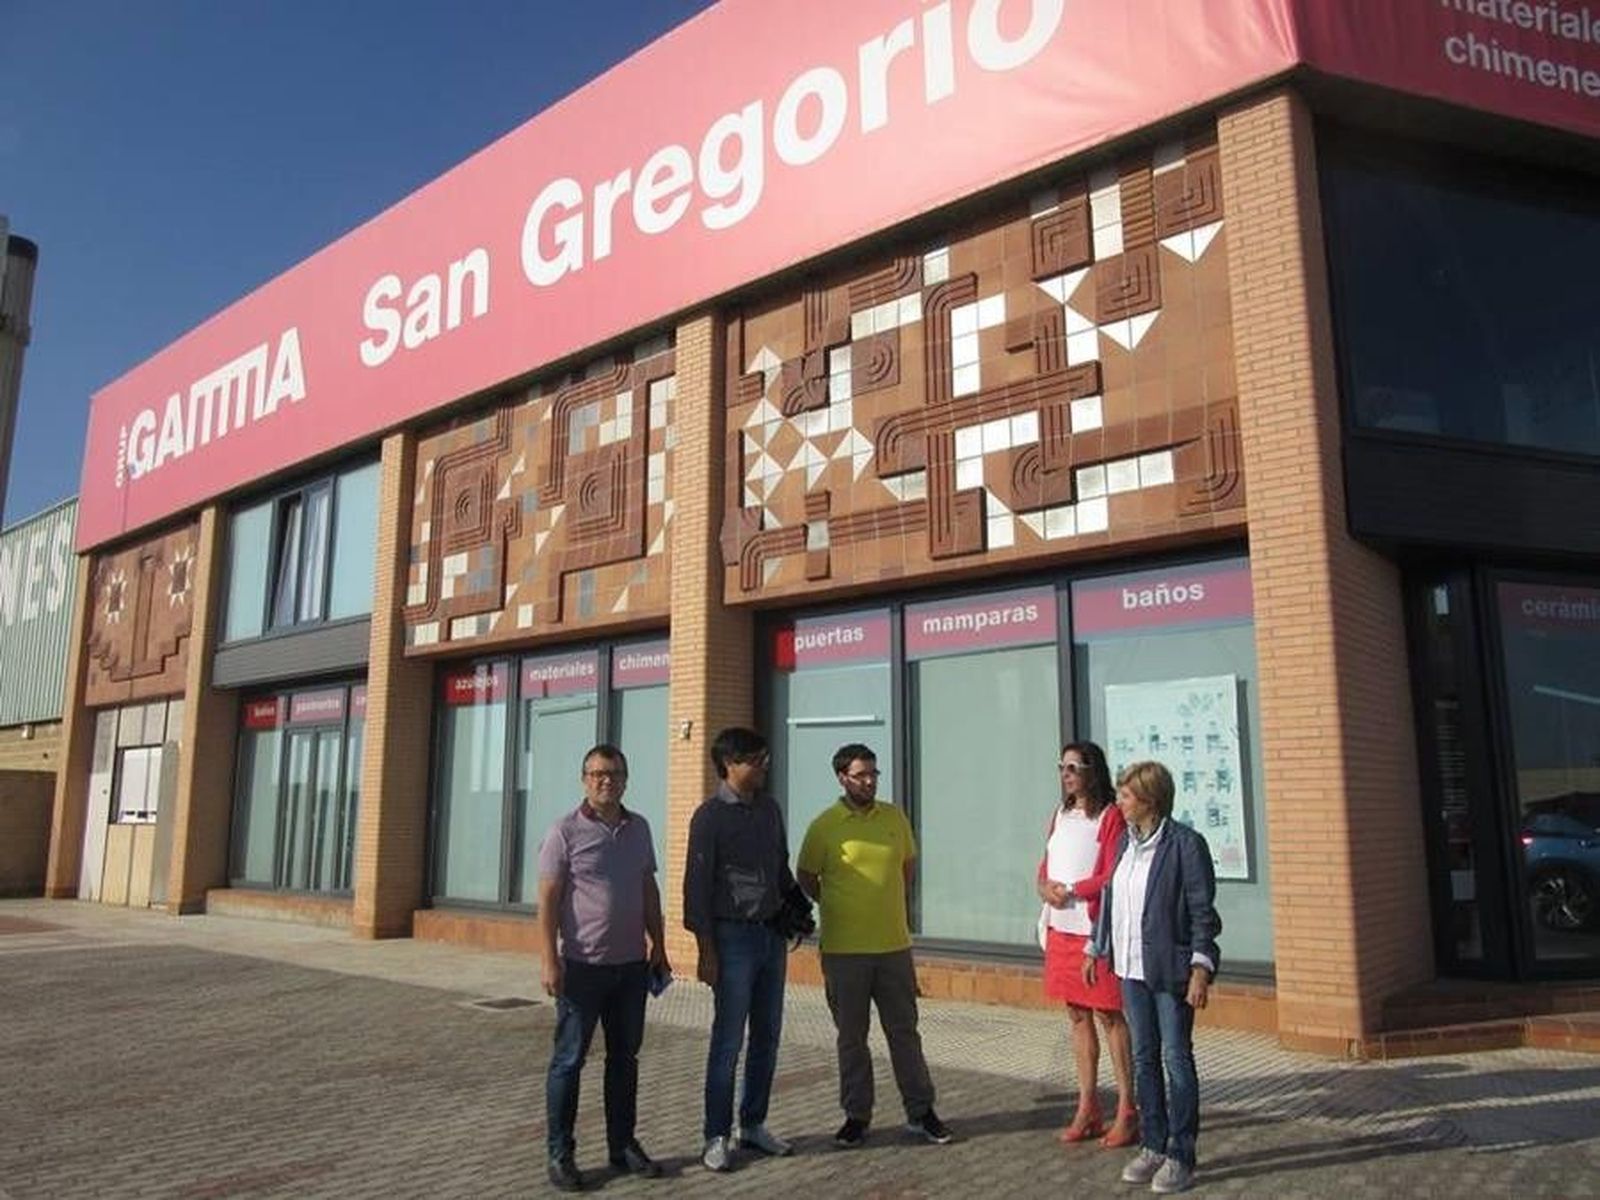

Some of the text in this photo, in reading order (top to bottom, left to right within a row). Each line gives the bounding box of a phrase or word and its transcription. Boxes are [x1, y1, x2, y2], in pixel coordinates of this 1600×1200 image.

[1441, 0, 1600, 43] aterial
[1444, 31, 1600, 97] chimene
[127, 0, 1065, 480] GAMMA San Gregorio
[1121, 581, 1205, 610] baños
[922, 602, 1039, 635] mamparas
[794, 624, 864, 653] puertas
[454, 674, 498, 692] azujos
[529, 662, 594, 681] materiales
